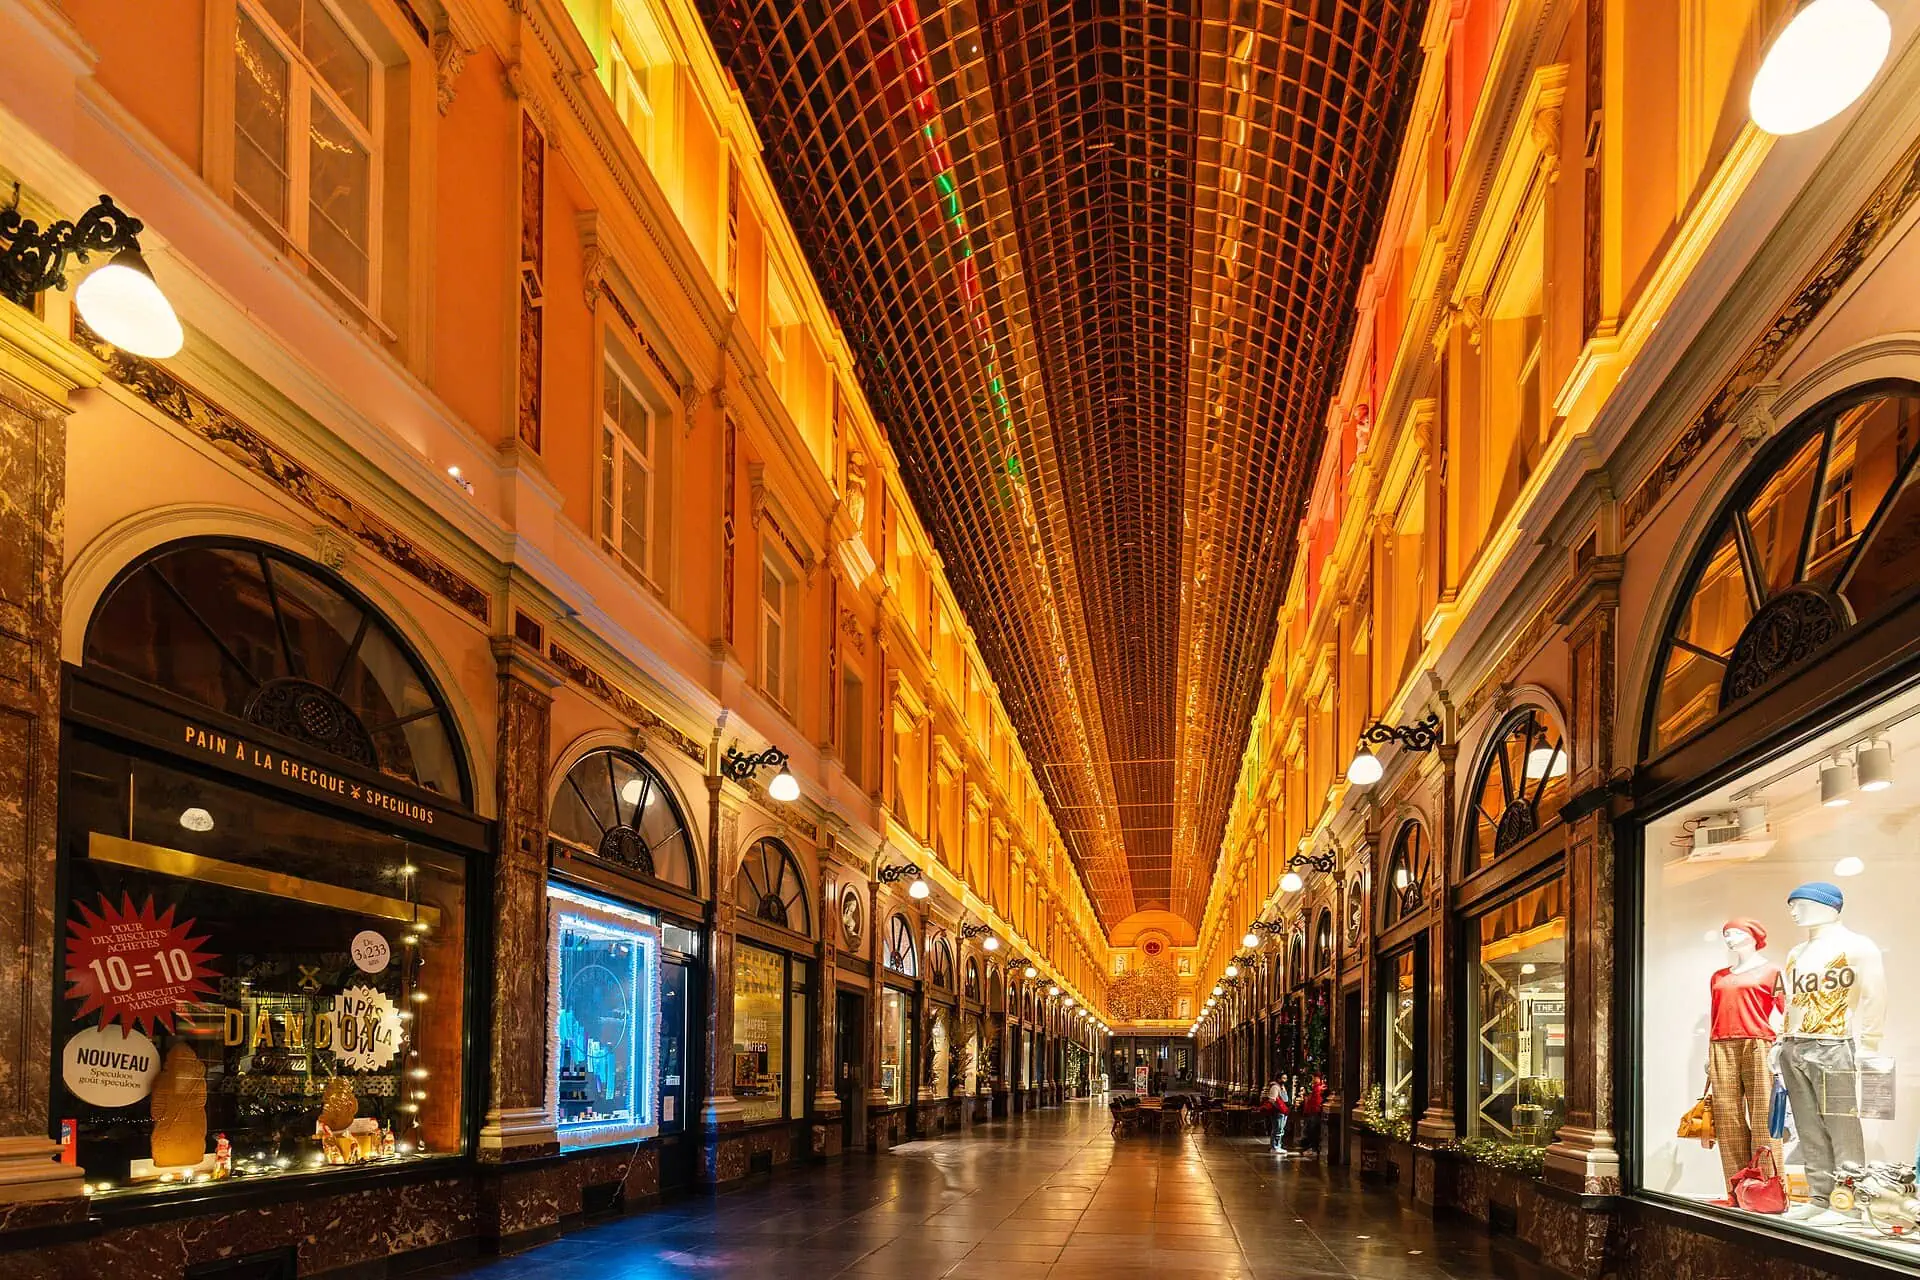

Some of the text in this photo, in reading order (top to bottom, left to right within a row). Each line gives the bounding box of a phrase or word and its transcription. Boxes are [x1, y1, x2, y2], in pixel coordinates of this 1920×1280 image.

[185, 726, 434, 824] PAIN À LA GRECQUE SPECULOOS
[91, 929, 168, 945] DIX BISCUITS
[111, 922, 144, 934] POUR
[366, 943, 387, 958] 233
[1772, 967, 1855, 997] Akaso
[112, 986, 186, 1005] DIX BISCUITS
[259, 991, 354, 1013] MAISON
[224, 1006, 379, 1053] DANDOY
[77, 1047, 149, 1073] NOUVEAU
